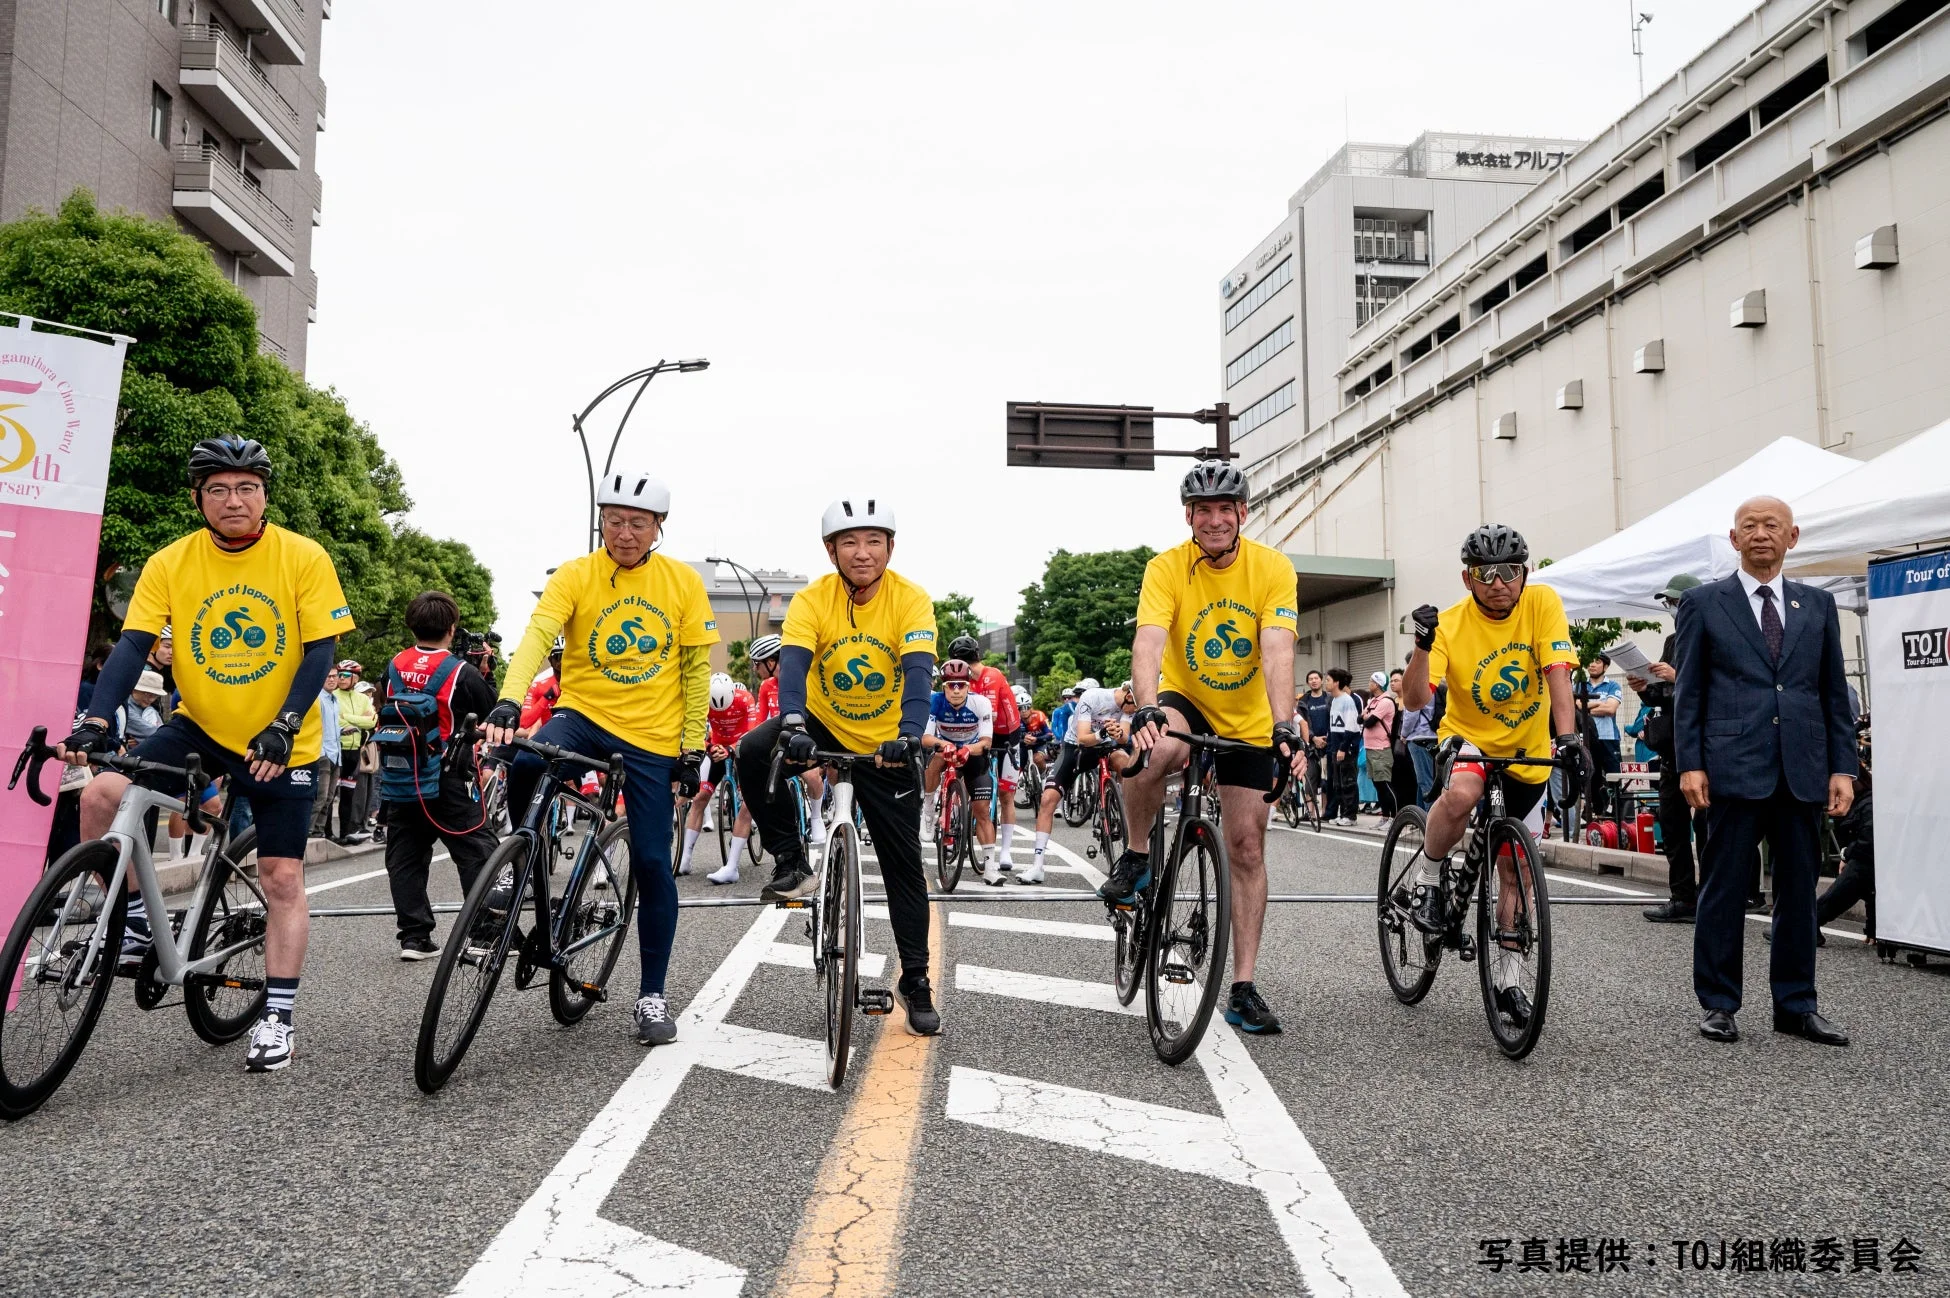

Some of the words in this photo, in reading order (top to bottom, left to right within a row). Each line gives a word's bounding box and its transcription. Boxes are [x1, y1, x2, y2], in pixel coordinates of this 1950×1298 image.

[0, 353, 57, 381] gamihara
[57, 381, 75, 414] Chuo
[59, 420, 81, 454] Ward
[1906, 569, 1933, 583] Tour
[1937, 563, 1950, 579] of
[228, 584, 240, 594] of
[242, 585, 275, 607] Japan
[624, 596, 634, 605] of
[636, 597, 664, 618] Japan
[1217, 598, 1227, 608] of
[1229, 599, 1257, 620] Japan
[851, 632, 863, 643] of
[908, 633, 933, 642] AMANO
[1904, 632, 1943, 657] TOJ
[191, 622, 206, 665] AMANO
[205, 660, 277, 685] SAGAMIHARA
[274, 622, 286, 656] STAGE
[588, 629, 601, 669] AMANO
[601, 663, 662, 684] SAGAMIHARA
[660, 632, 673, 661] STAGE
[1185, 632, 1198, 672] AMANO
[1198, 666, 1259, 691] SAGAMIHARA
[1478, 650, 1499, 669] Tour
[1926, 657, 1943, 666] Japan
[830, 699, 894, 721] SAGAMIHARA
[1471, 682, 1490, 715] AMANO
